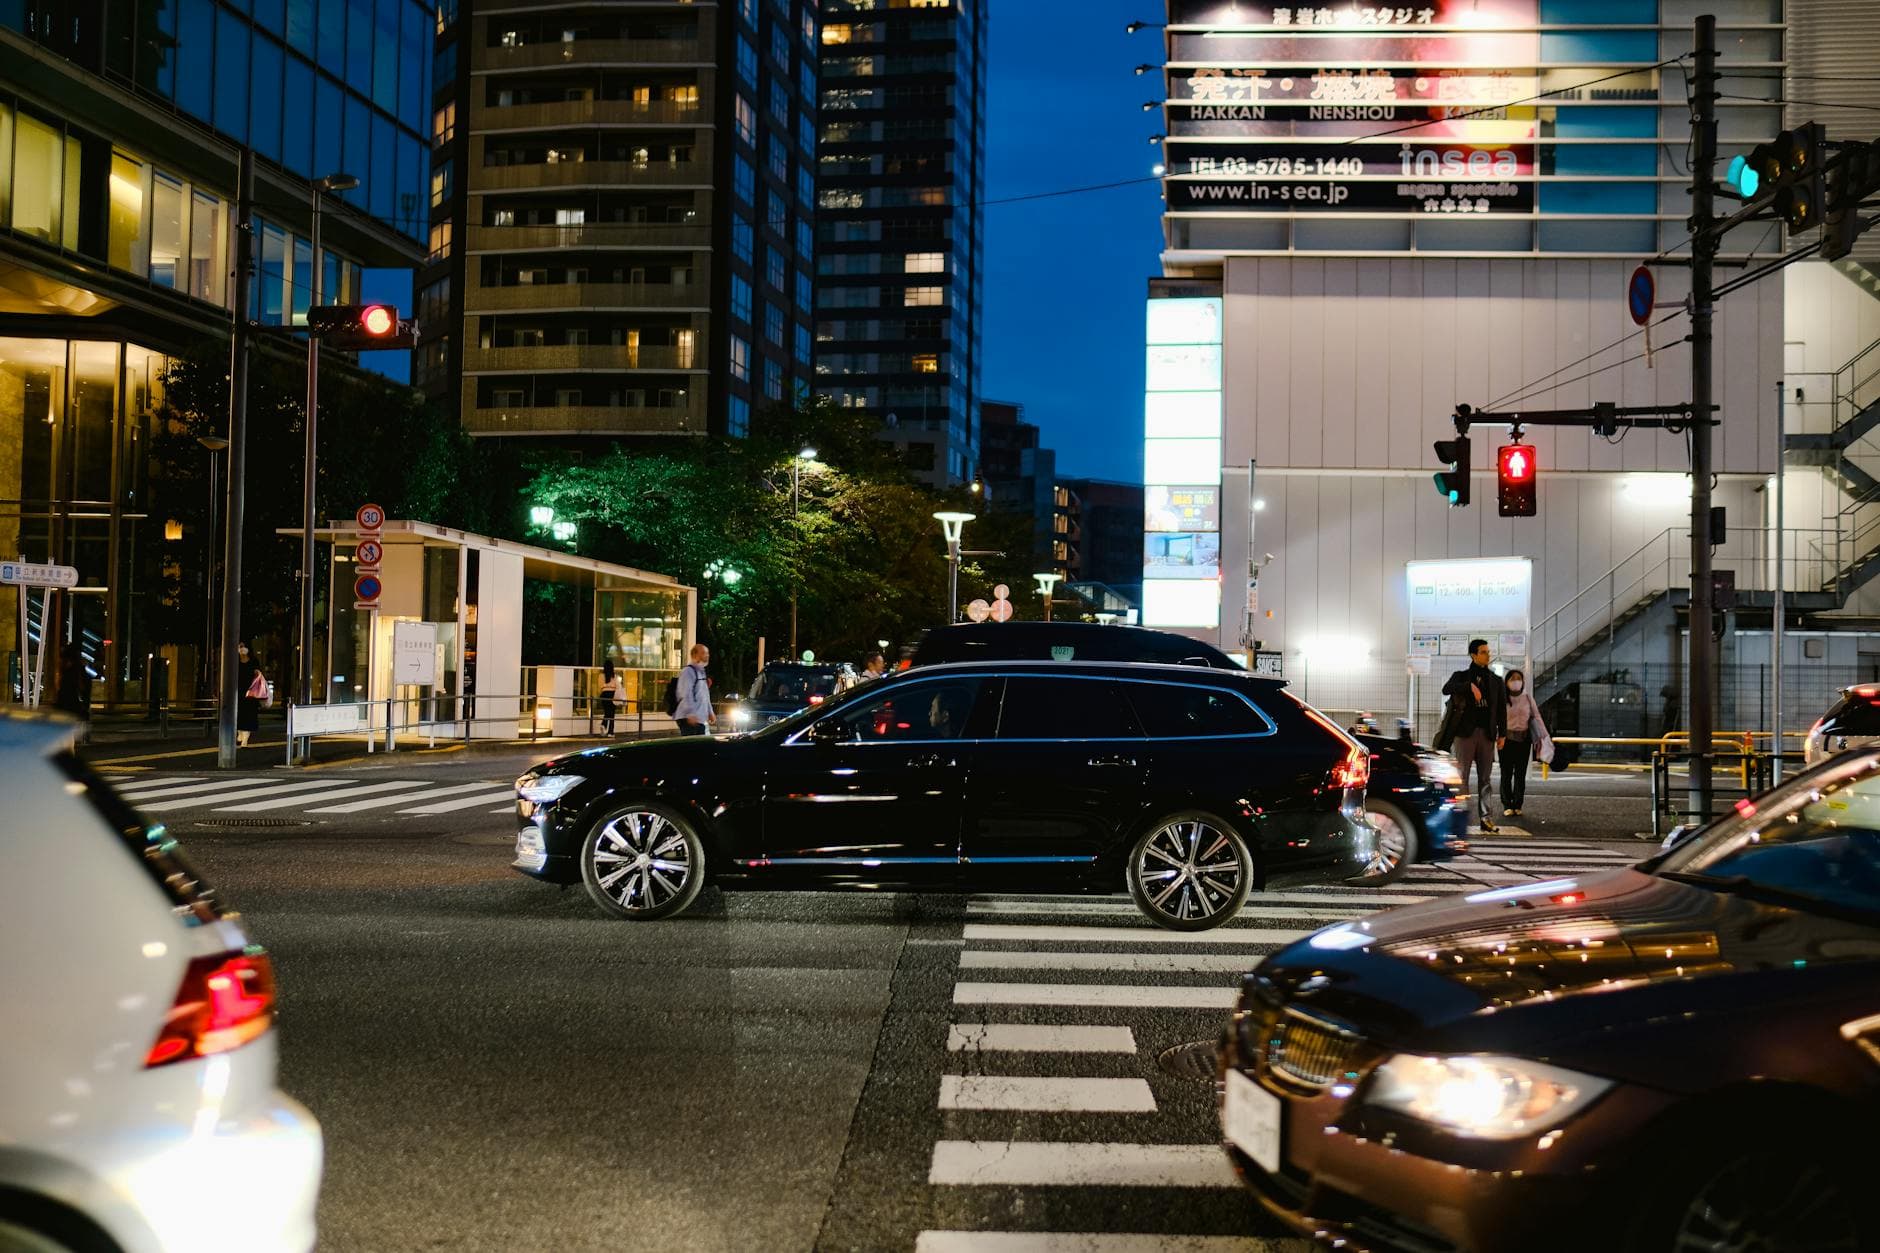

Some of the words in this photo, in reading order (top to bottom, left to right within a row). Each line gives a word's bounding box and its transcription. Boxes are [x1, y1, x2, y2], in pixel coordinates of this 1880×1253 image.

[1273, 8, 1435, 25] 溶岩ホスタジオ
[1190, 106, 1266, 120] HAKKAN
[1309, 106, 1396, 120] NENSHOU
[1398, 143, 1518, 177] insea
[1188, 182, 1349, 204] www.in-sea.jp
[364, 511, 378, 523] 30
